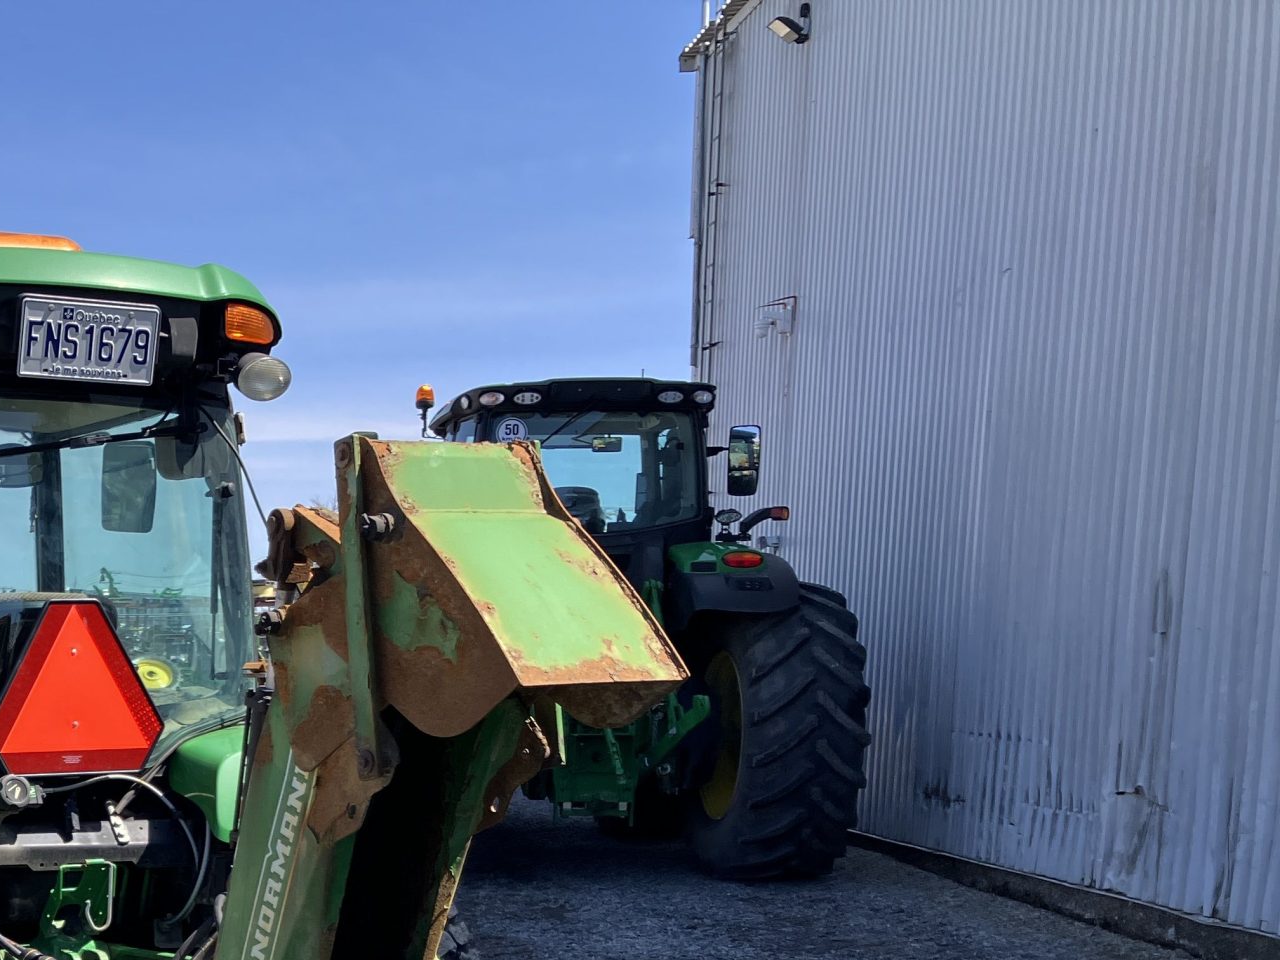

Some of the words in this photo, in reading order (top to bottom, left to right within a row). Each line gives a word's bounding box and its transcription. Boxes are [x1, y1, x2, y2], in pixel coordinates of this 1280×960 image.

[75, 309, 121, 325] Québec
[26, 319, 151, 366] FNS1679
[49, 363, 62, 374] Je
[64, 366, 78, 375] me
[80, 366, 123, 378] souviens
[504, 423, 519, 436] 50
